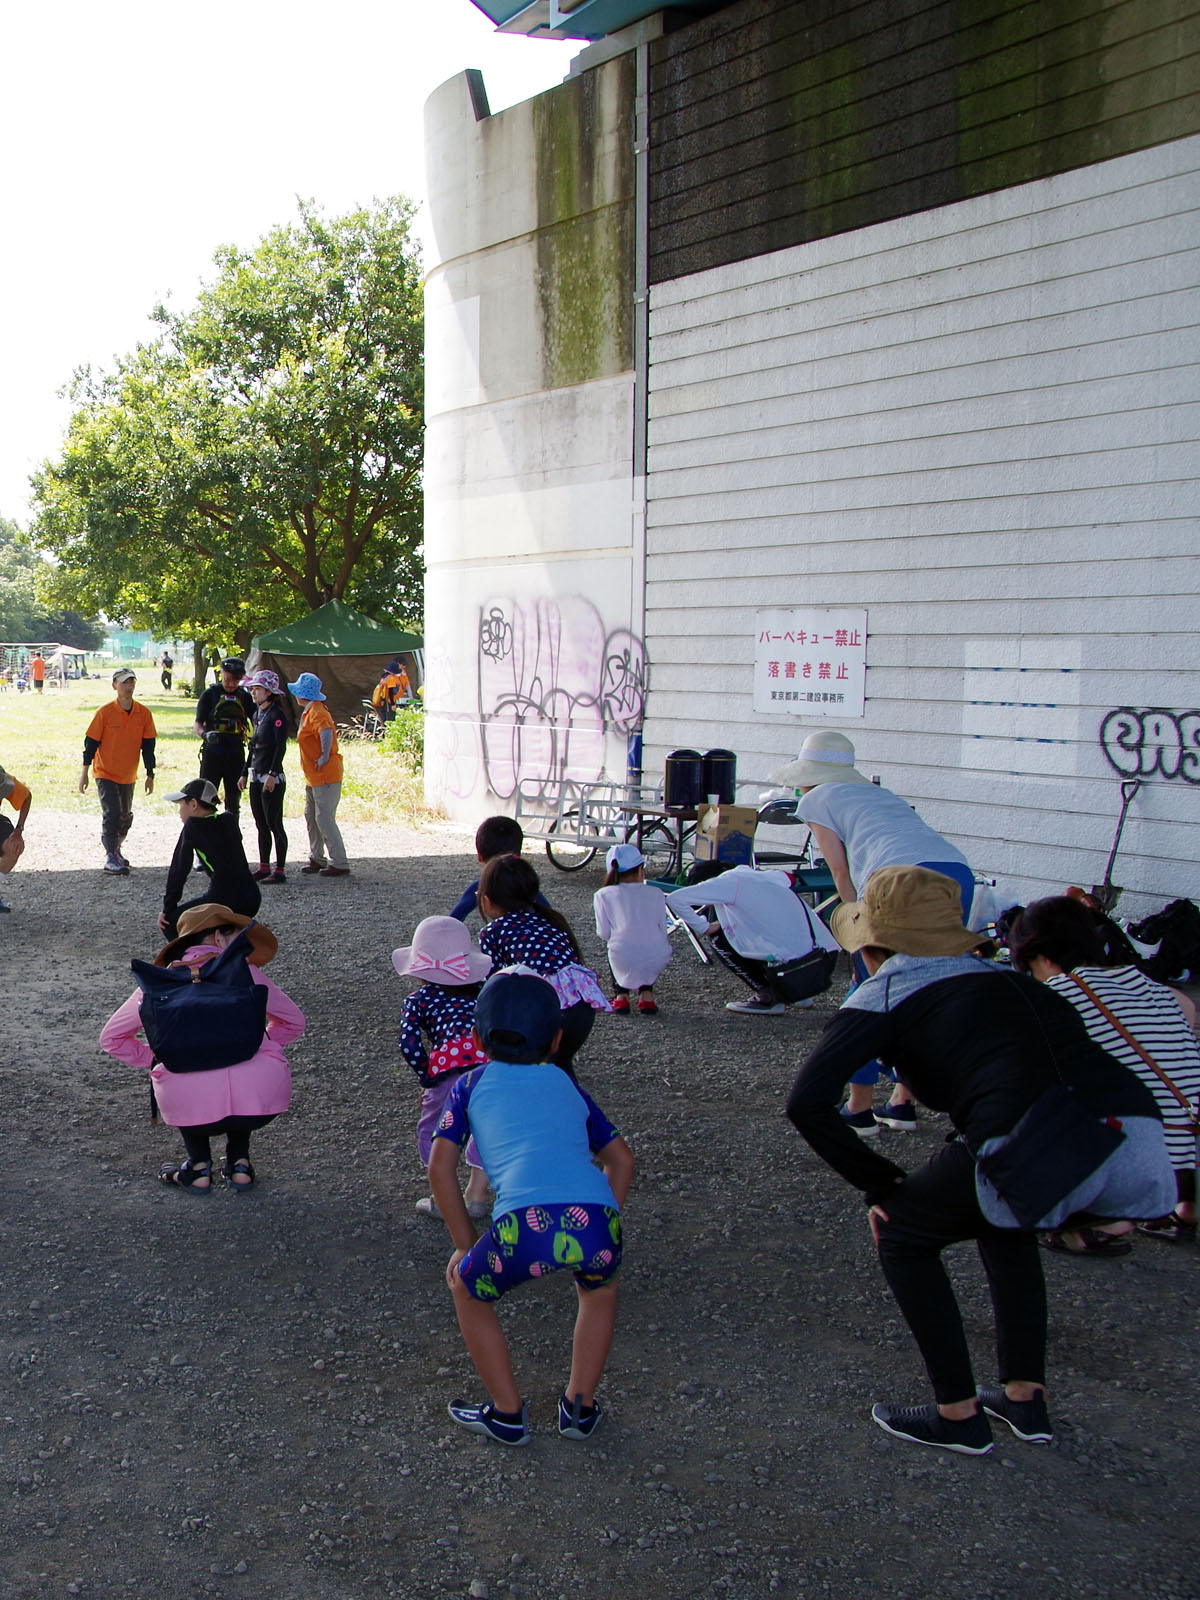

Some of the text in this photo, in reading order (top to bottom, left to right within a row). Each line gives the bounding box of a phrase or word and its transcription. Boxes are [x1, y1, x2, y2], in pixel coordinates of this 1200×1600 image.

[759, 629, 861, 646] バーベキュー禁止
[767, 661, 848, 680] 落書き禁止
